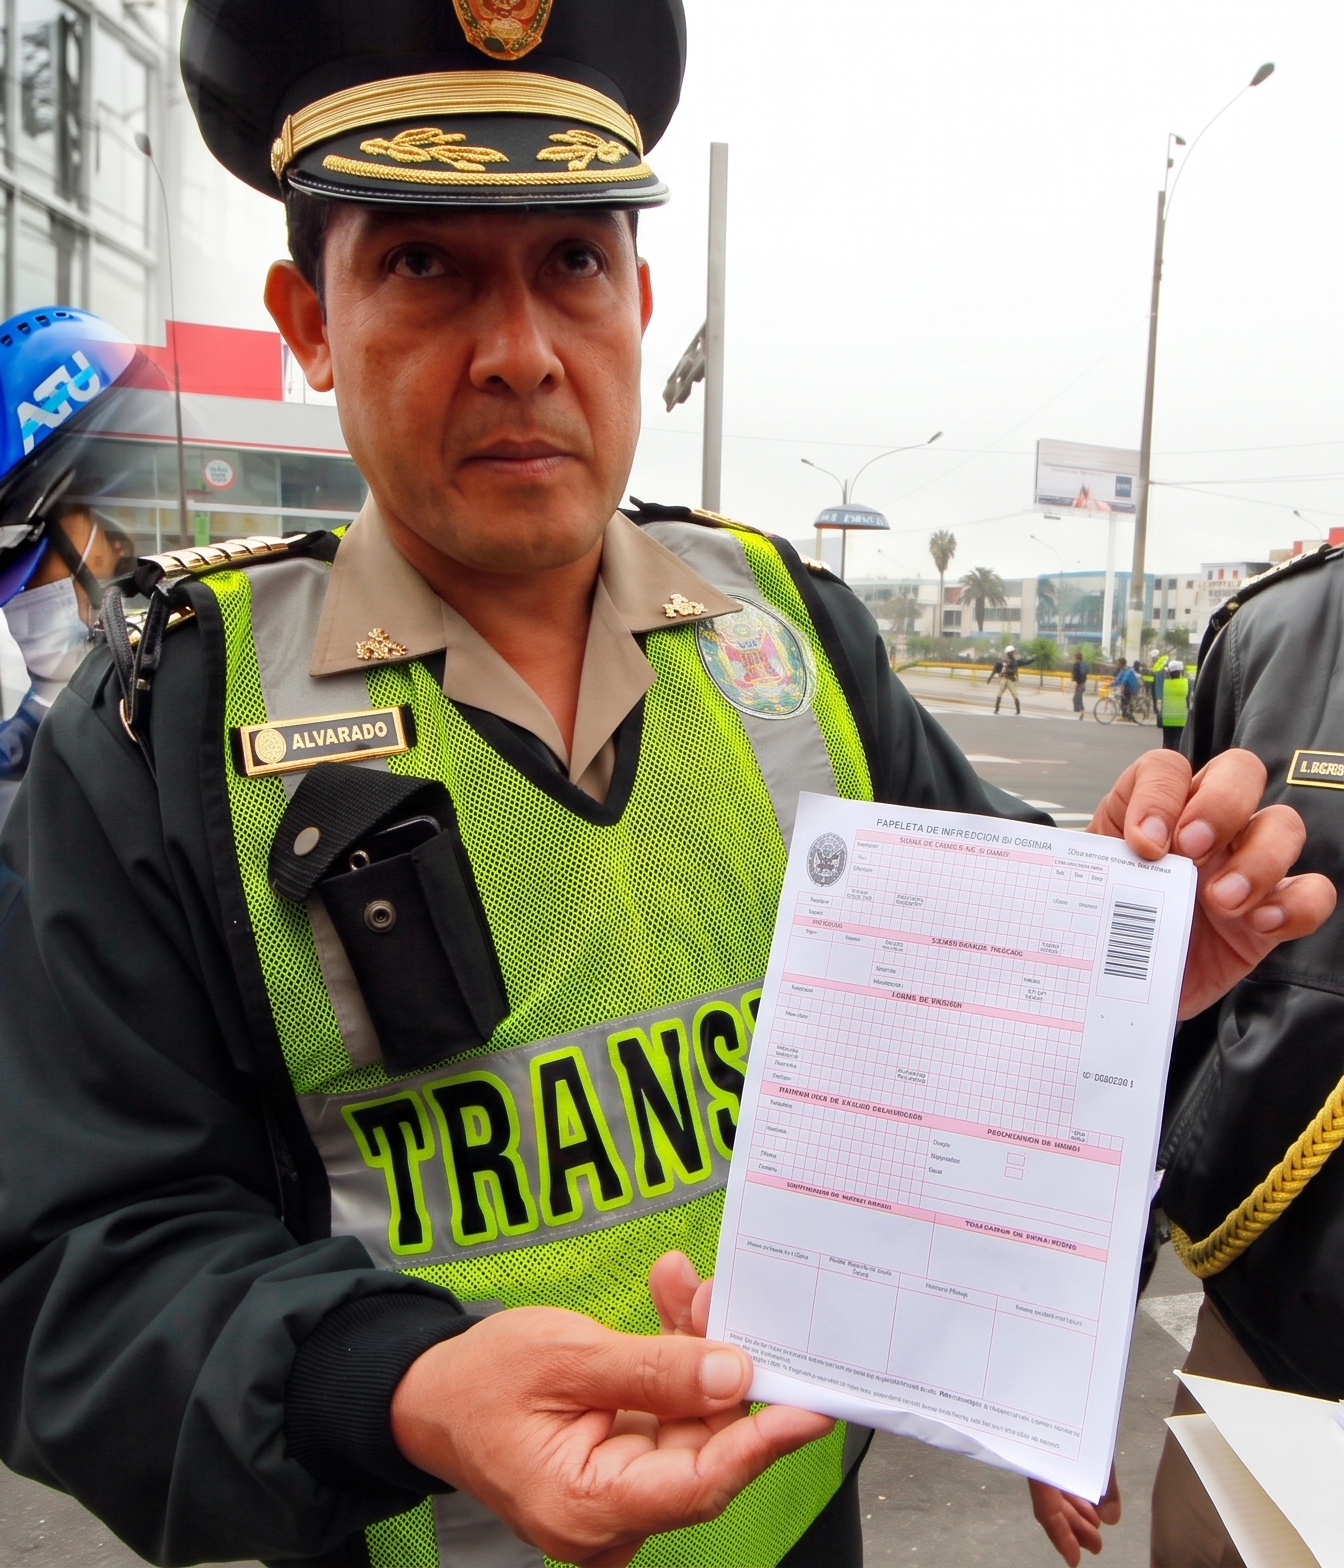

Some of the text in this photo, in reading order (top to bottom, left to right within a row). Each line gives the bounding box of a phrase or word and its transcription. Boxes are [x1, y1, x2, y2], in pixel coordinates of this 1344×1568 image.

[17, 350, 100, 456] ATU
[292, 720, 389, 750] ALVARADO
[926, 825, 940, 835] DE
[341, 988, 764, 1257] TRANS
